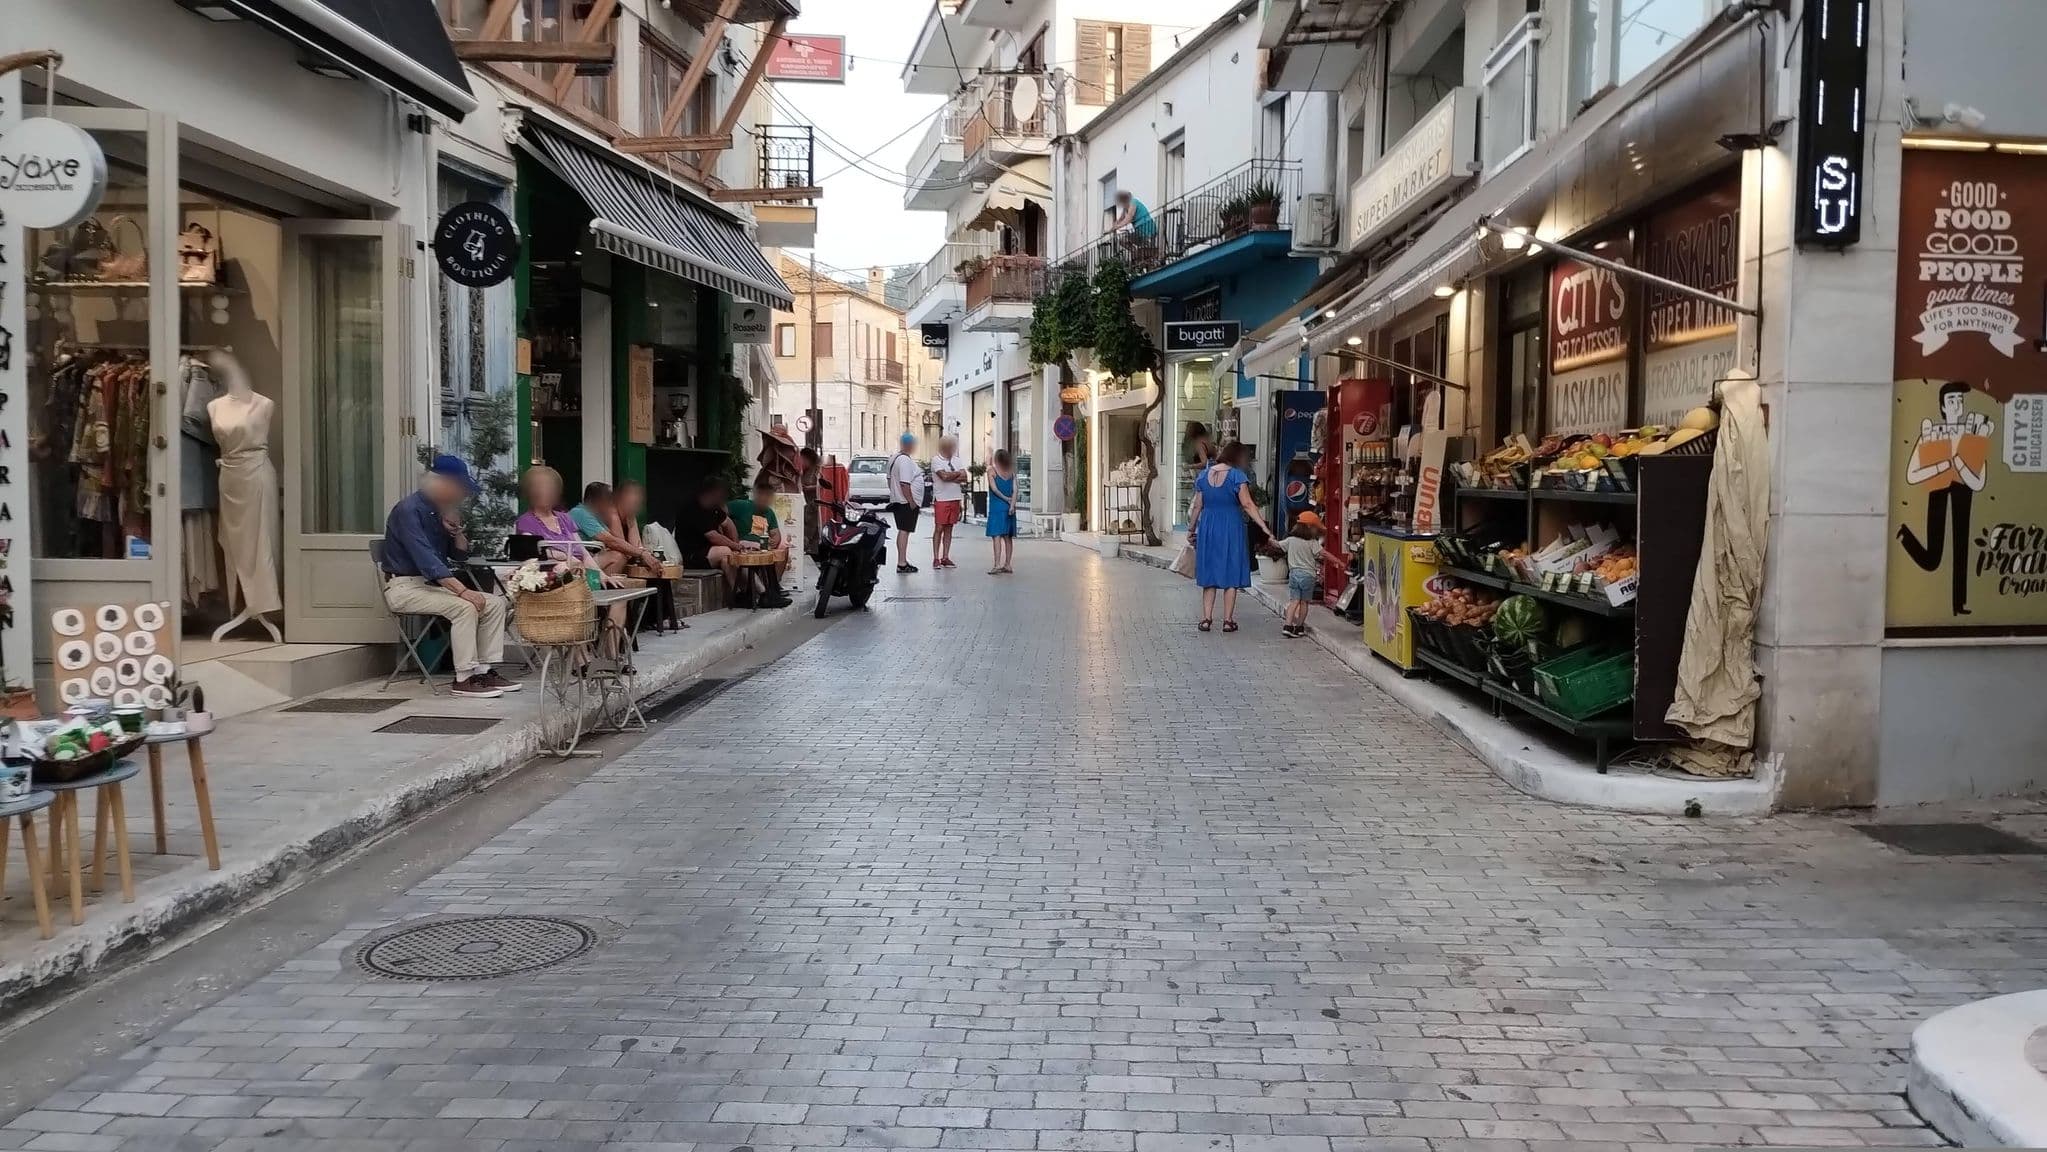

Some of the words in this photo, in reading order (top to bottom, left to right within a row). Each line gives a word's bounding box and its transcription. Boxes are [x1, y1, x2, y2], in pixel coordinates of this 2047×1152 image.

[1356, 194, 1389, 236] SUPER
[1393, 148, 1442, 209] MARKET
[1951, 181, 1998, 208] GOOD
[444, 211, 505, 239] CLOTHING
[1934, 208, 2012, 230] FOOD
[1926, 232, 2018, 255] GOOD
[445, 252, 507, 278] BOUTIQUE
[1650, 208, 1741, 307] LASKARI
[1919, 260, 2023, 283] PEOPLE
[1557, 258, 1625, 336] CITY'S
[1926, 283, 1971, 310] good
[1971, 284, 2015, 306] times
[1650, 300, 1691, 343] SUPER
[1695, 286, 1739, 332] MARK
[1924, 307, 1953, 324] LIFE'S
[1956, 306, 1979, 316] TOO
[1981, 307, 2015, 325] SHORT
[1933, 320, 1953, 335] FOR
[1956, 319, 2005, 335] ANYTHING
[1179, 326, 1225, 344] bugatti
[1556, 326, 1621, 361] DELICATESSEN
[1555, 371, 1623, 428] LASKARIS
[1297, 411, 1315, 420] pep
[2012, 398, 2030, 467] CITY'S
[2030, 398, 2044, 467] DELICATESSEN
[1991, 523, 2047, 551] Far
